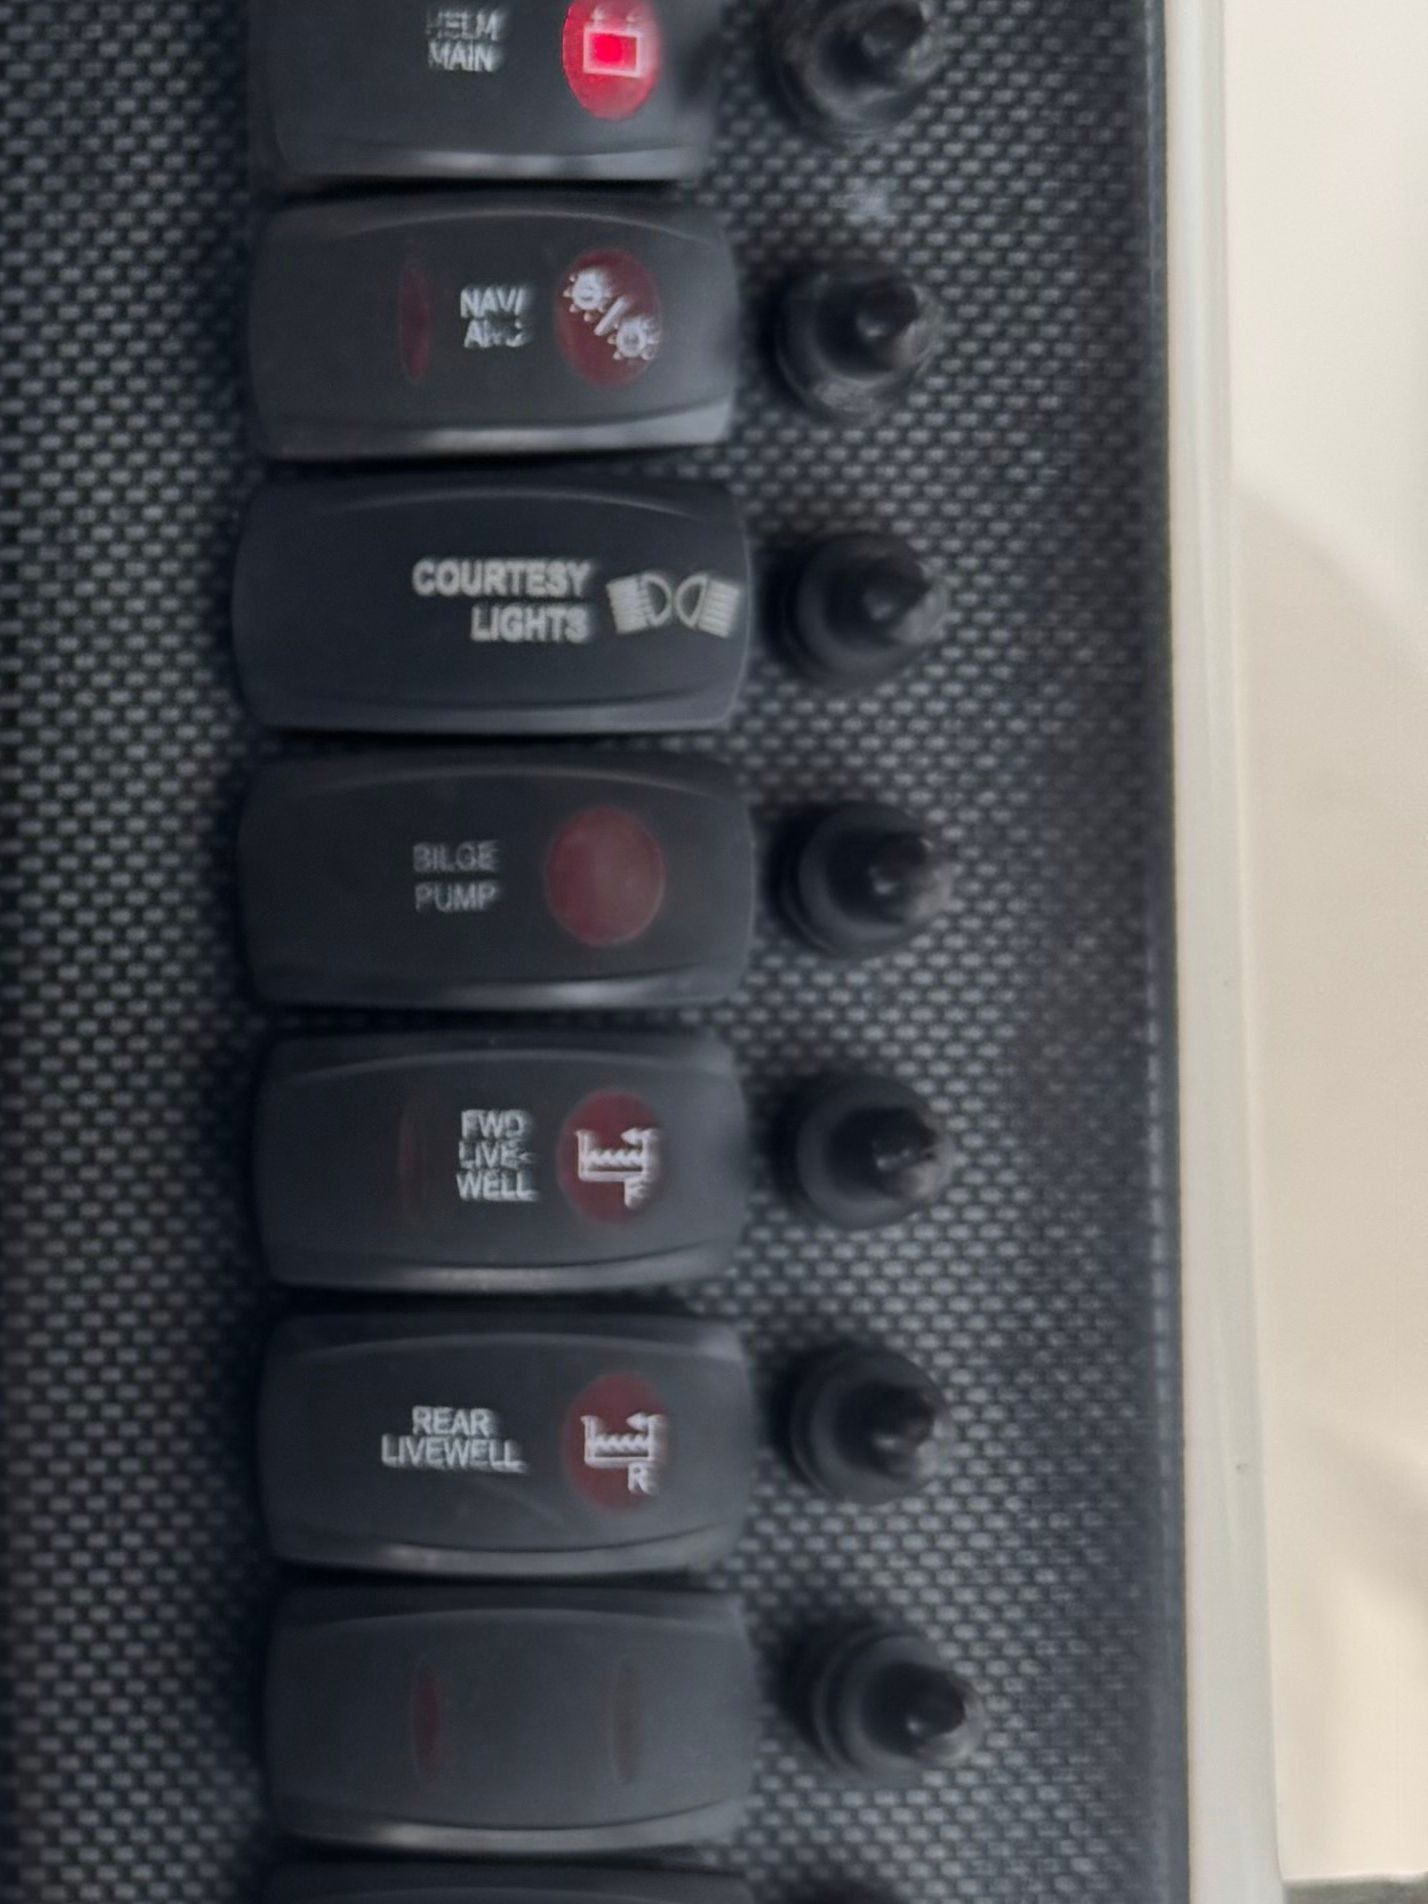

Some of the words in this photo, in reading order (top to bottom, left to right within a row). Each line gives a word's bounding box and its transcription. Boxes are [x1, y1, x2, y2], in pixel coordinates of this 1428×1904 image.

[427, 40, 502, 73] MAIN
[412, 559, 592, 596] COURTESY
[469, 605, 590, 642] LIGHTS
[412, 839, 500, 873] BILGE
[414, 883, 499, 912] PUMP
[460, 1110, 528, 1140] FWD
[458, 1140, 533, 1170] LIVE-
[456, 1171, 538, 1201] WELL
[412, 1405, 496, 1437] REAR
[381, 1434, 529, 1473] LIVEWELL
